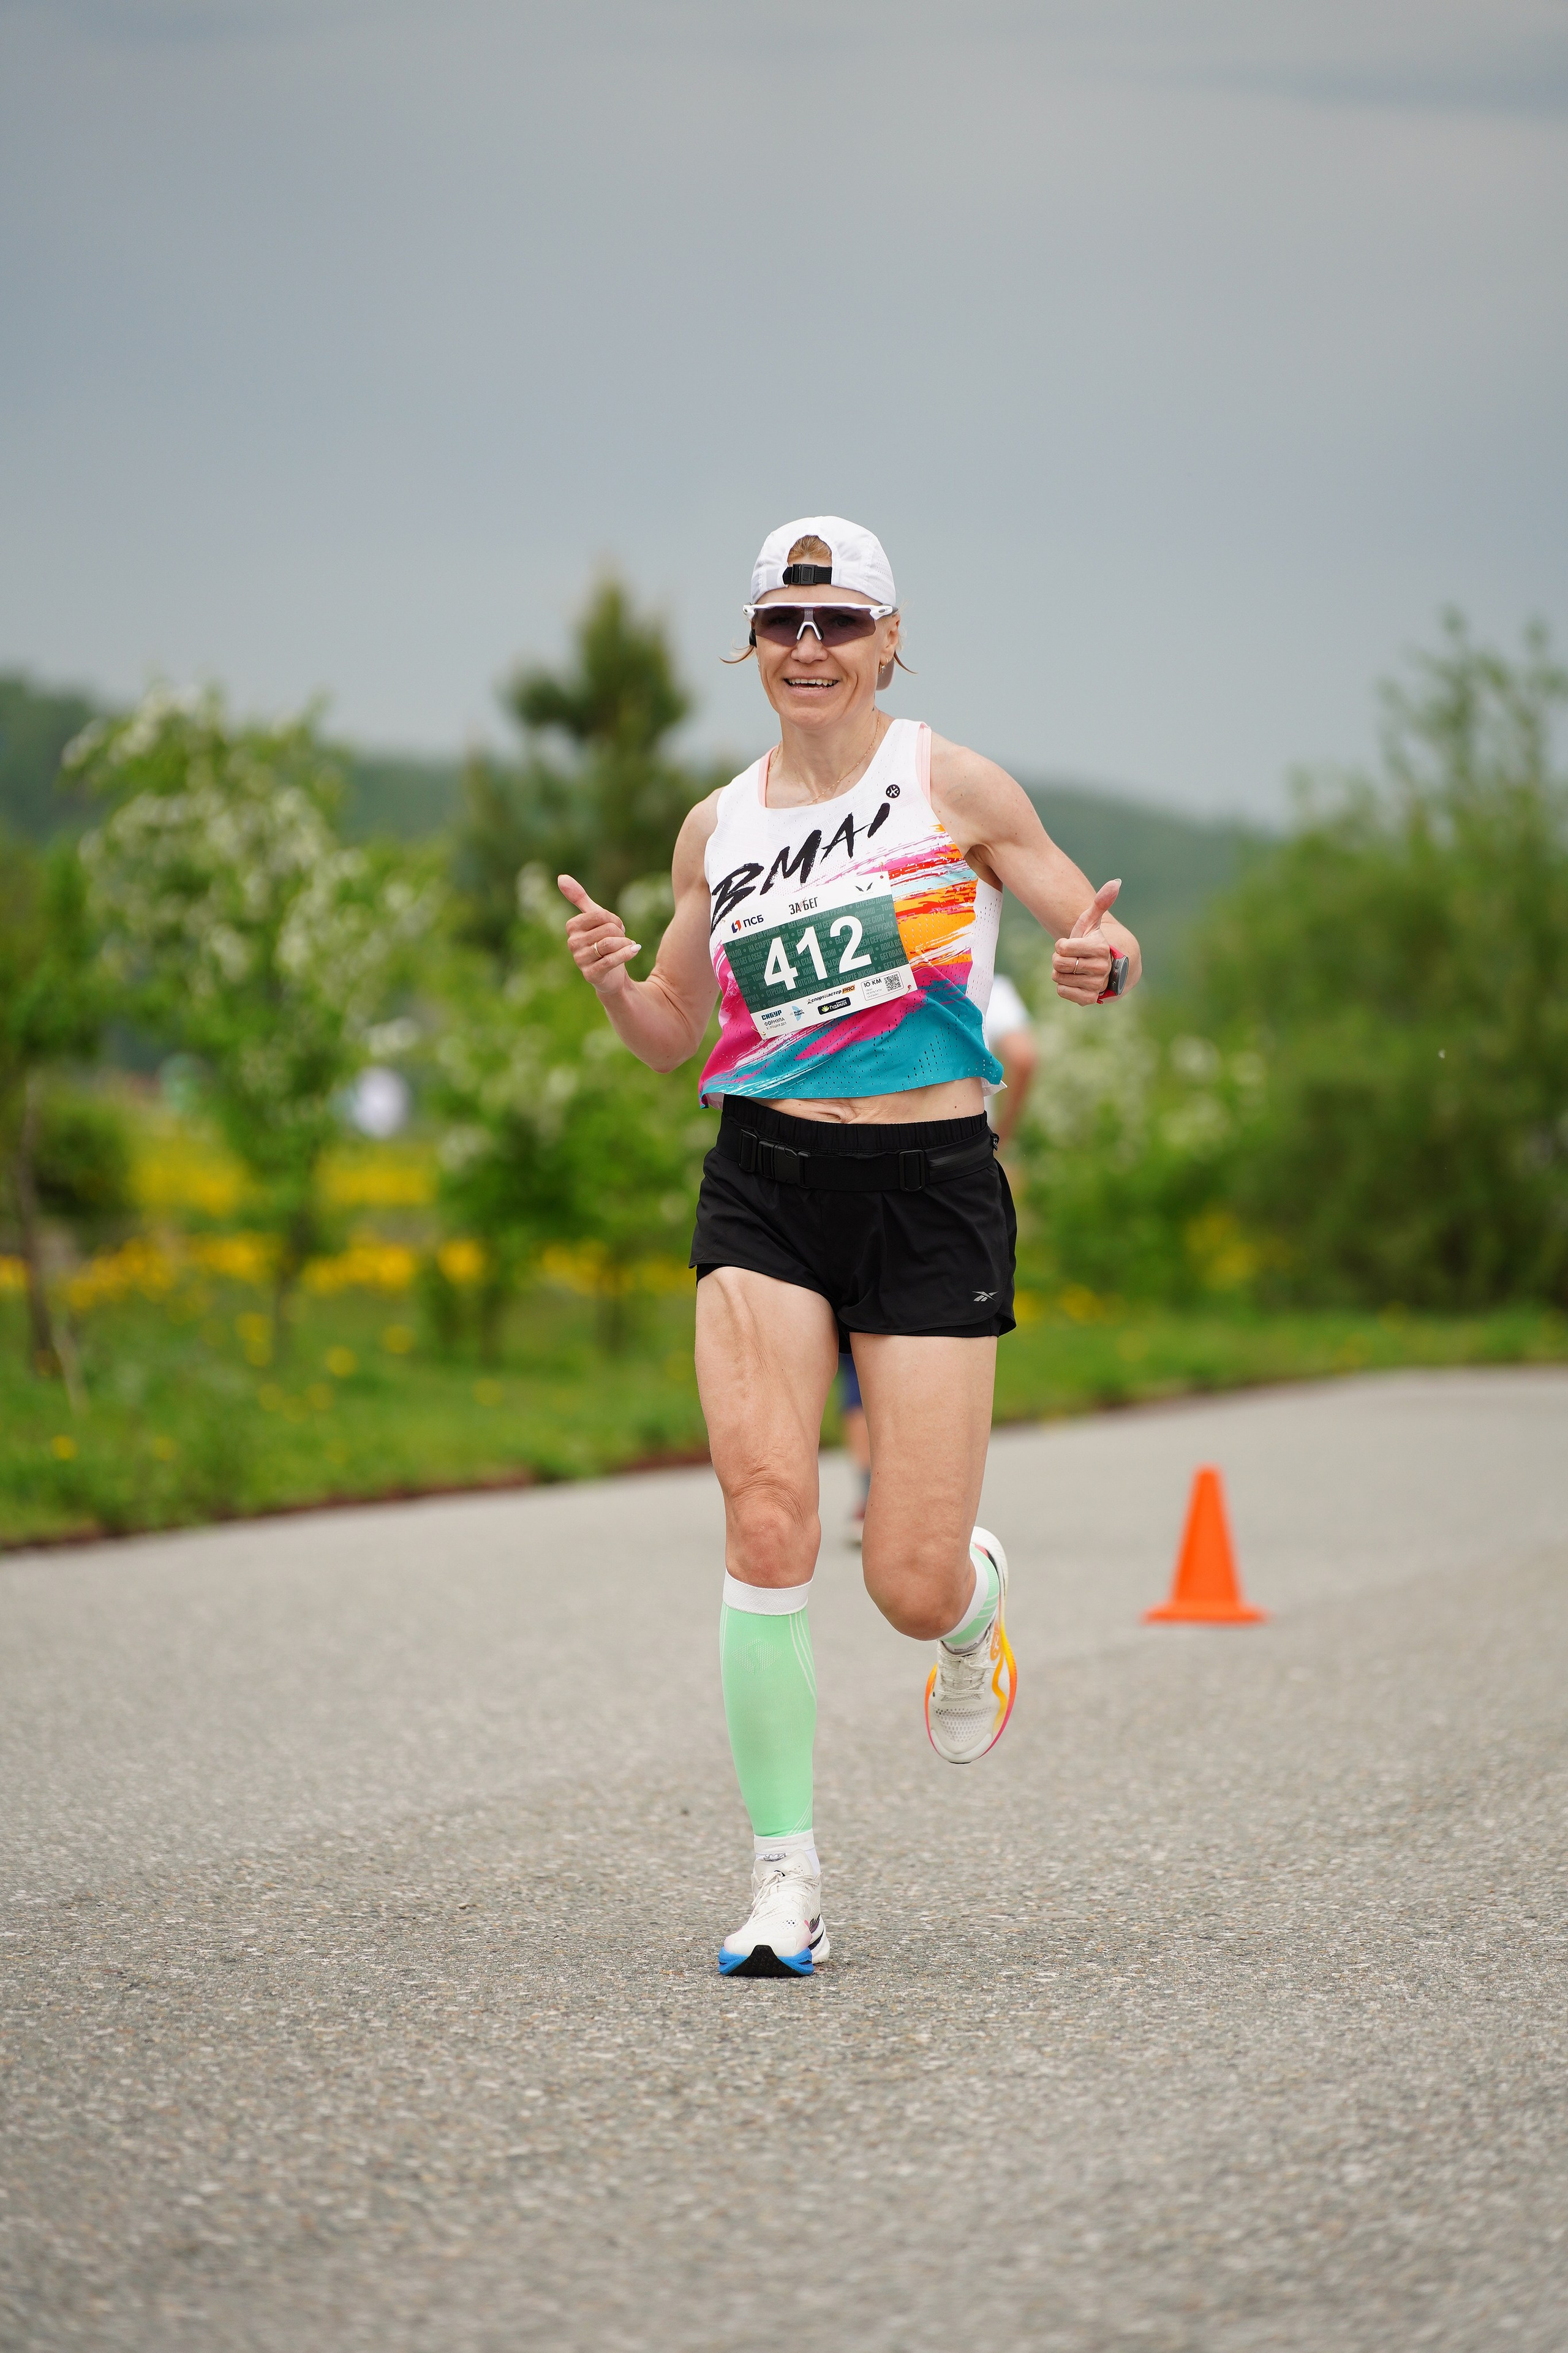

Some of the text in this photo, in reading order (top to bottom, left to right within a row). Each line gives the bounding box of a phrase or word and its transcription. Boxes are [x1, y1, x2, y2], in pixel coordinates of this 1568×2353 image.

[710, 803, 890, 936] BMAI
[743, 914, 764, 927] ПСБ
[872, 913, 885, 923] СПЯТ
[870, 931, 893, 945] СЕРДЦЕМ
[881, 940, 894, 951] ПОКА
[752, 951, 763, 961] СЕБЕ
[764, 915, 872, 991] 412
[839, 972, 858, 984] СТАРТЕ
[858, 966, 875, 978] ЖИЗНИ
[762, 1010, 782, 1020] СИБУР
[764, 1016, 785, 1026] ФОРМУЛА
